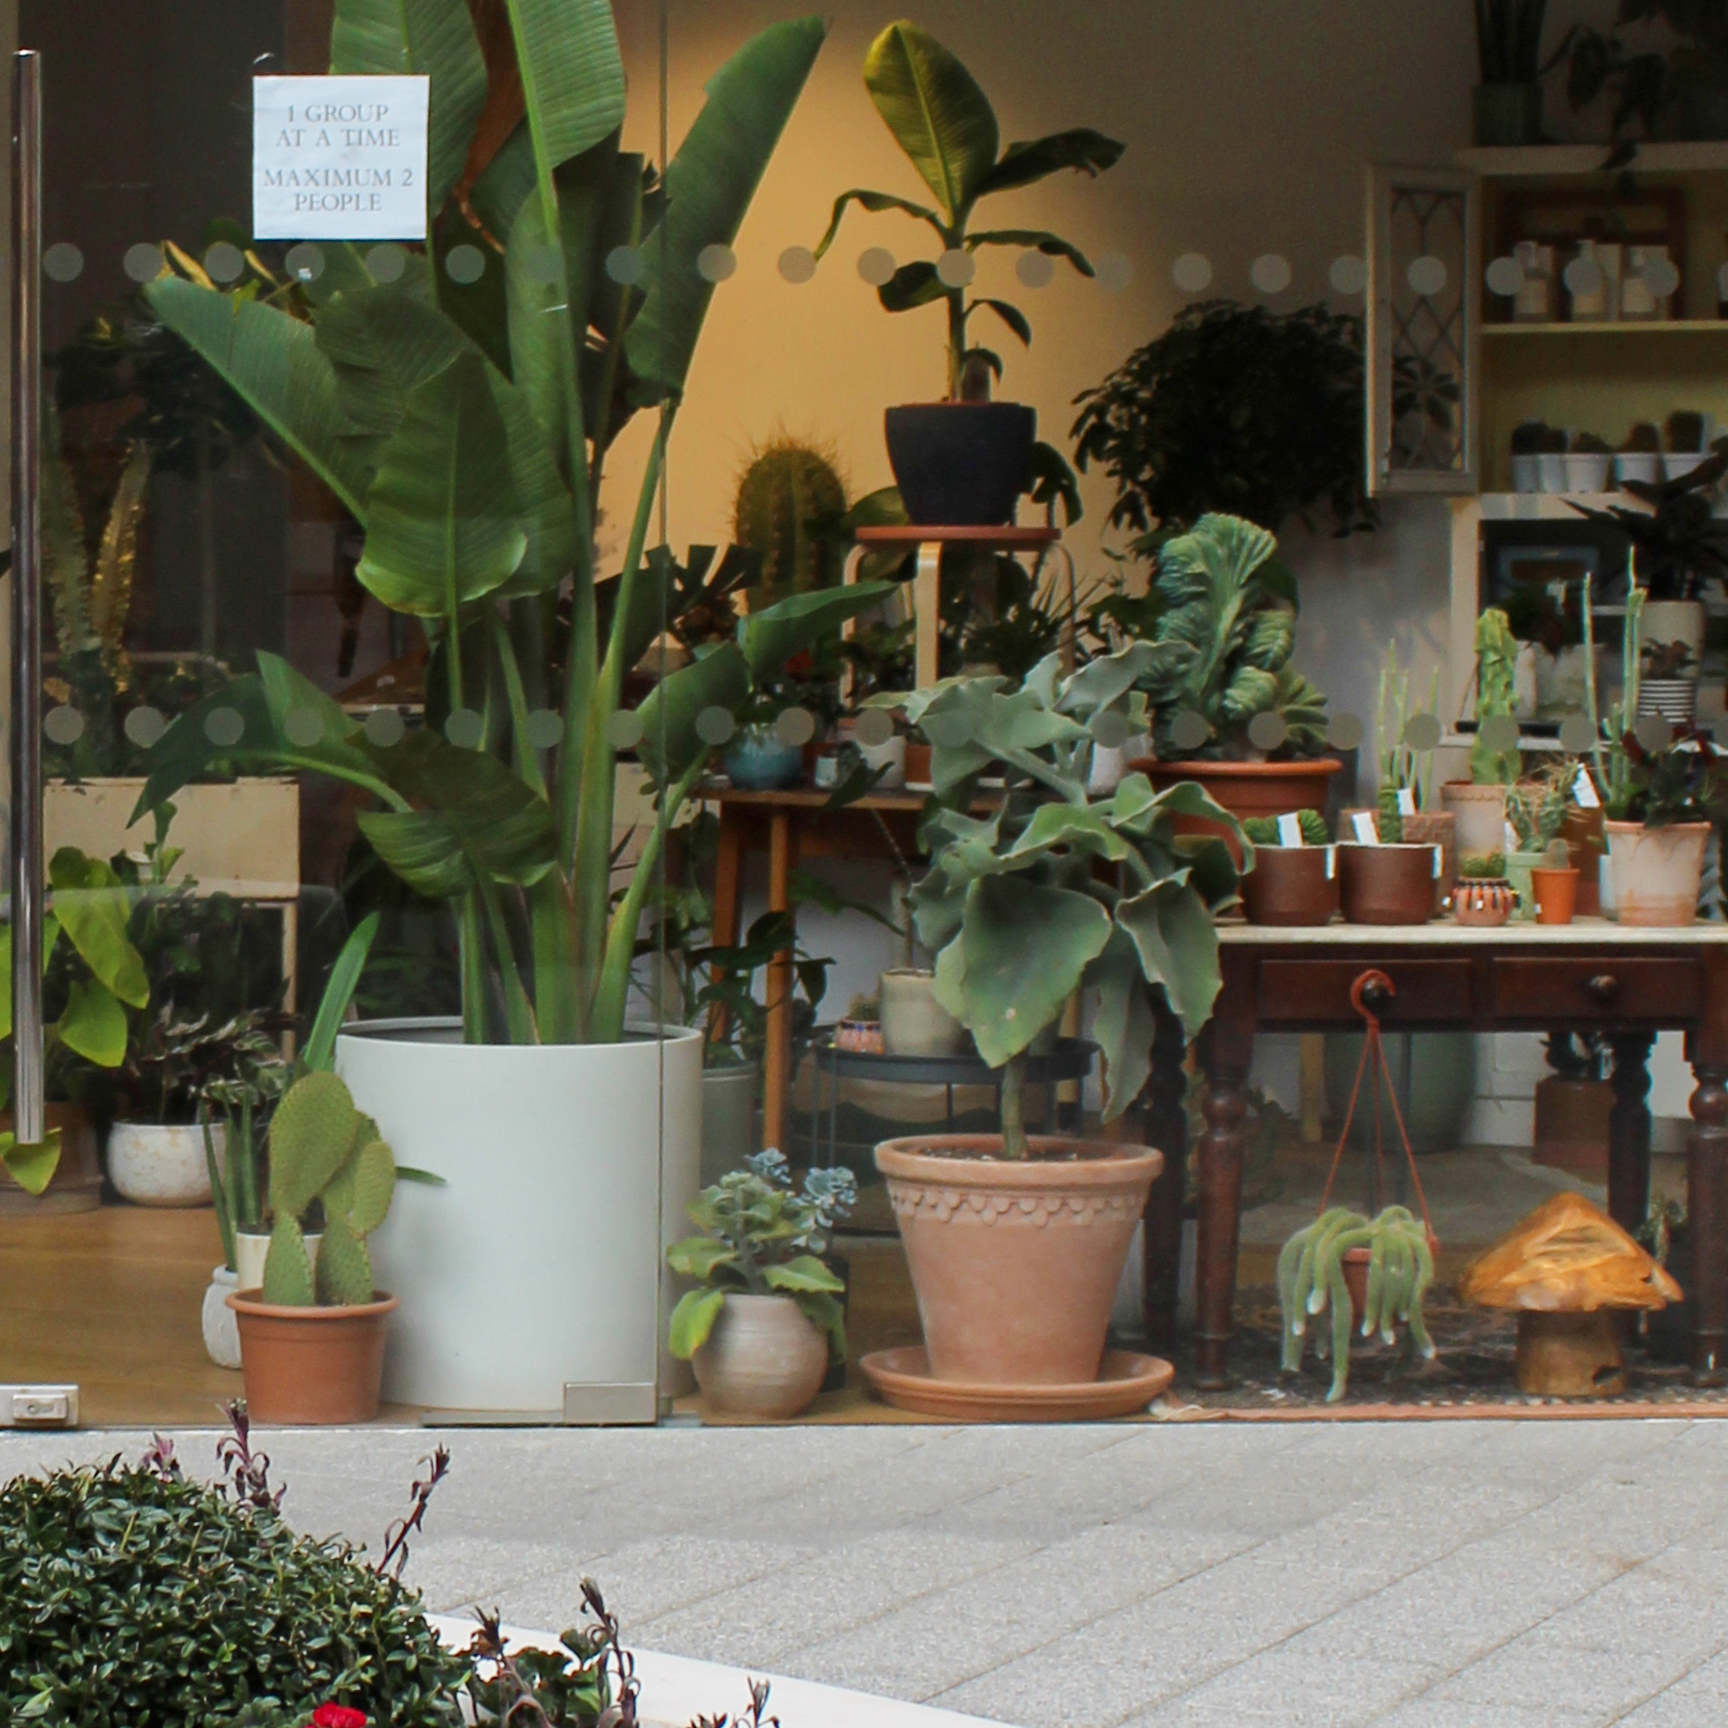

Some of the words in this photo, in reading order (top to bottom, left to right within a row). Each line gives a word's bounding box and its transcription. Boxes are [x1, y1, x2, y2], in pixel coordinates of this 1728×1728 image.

[287, 104, 294, 123] 1
[304, 104, 389, 123] GROUP
[276, 128, 306, 147] AT
[315, 128, 331, 147] A
[340, 128, 401, 147] TIME
[263, 168, 392, 187] MAXIMUM
[401, 168, 414, 187] 2
[294, 192, 382, 211] PEOPLE
